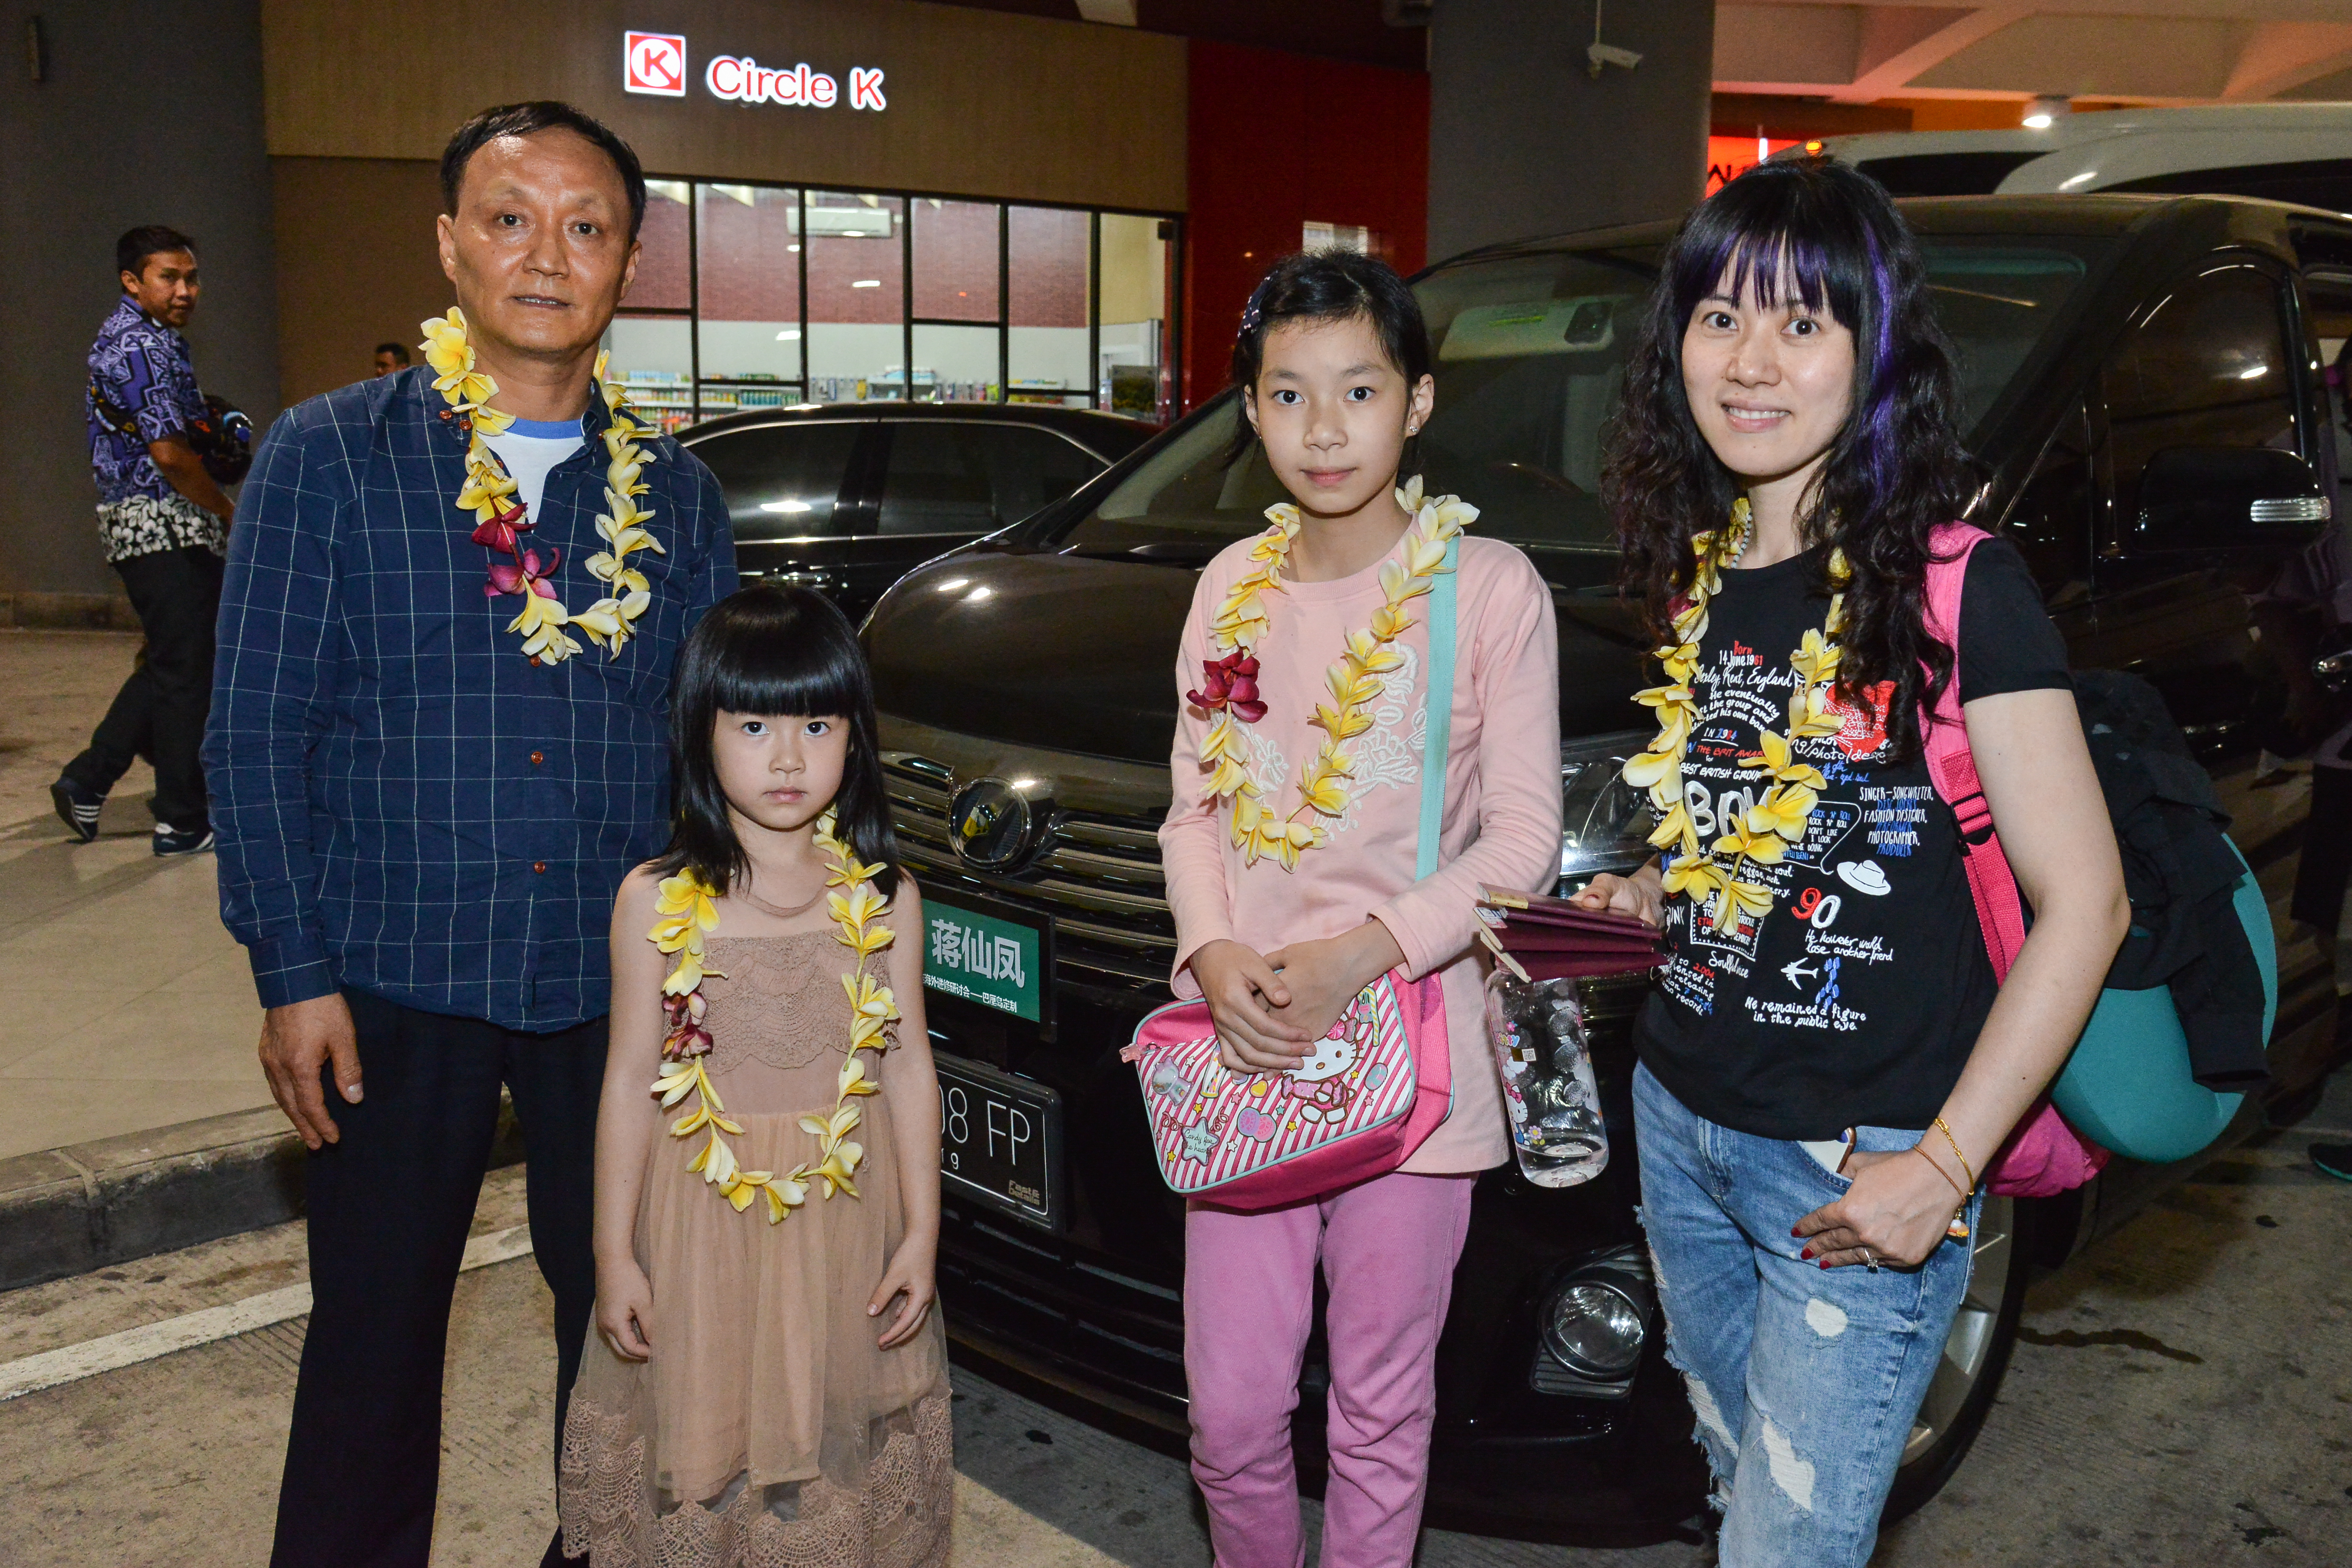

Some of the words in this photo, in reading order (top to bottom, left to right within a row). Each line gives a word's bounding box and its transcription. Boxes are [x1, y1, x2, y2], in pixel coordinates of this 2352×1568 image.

[711, 57, 835, 105] Circle
[854, 70, 884, 108] K
[1747, 666, 1794, 693] England
[1709, 690, 1722, 700] He
[1725, 689, 1781, 718] eventually
[1710, 700, 1724, 711] the
[1725, 699, 1752, 710] group
[1753, 707, 1775, 724] and
[1720, 707, 1732, 717] his
[1733, 712, 1748, 721] own
[1749, 716, 1766, 733] ban
[1703, 727, 1715, 738] IN
[1715, 728, 1738, 741] 1984
[1697, 745, 1712, 755] THE
[1713, 748, 1735, 757] BRIT
[1680, 762, 1702, 775] BEST
[1700, 767, 1732, 779] BRITISH
[1808, 817, 1822, 826] ROCK
[1837, 819, 1847, 828] ROLL
[1812, 809, 1826, 818] ROCK
[1840, 810, 1851, 820] ROLL
[1864, 809, 1895, 823] FASHION
[1808, 827, 1824, 835] DON'T
[1818, 836, 1831, 844] LOOK
[1807, 843, 1823, 852] DOING
[1876, 843, 1912, 857] PRODUCER
[1792, 887, 1841, 929] 90
[1702, 926, 1713, 935] OF
[1805, 929, 1818, 943] He
[1819, 930, 1859, 947] however
[1858, 936, 1883, 951] would
[931, 918, 1025, 988] 蒋仙凤
[1833, 946, 1870, 959] another
[1869, 948, 1893, 966] friend
[1679, 958, 1689, 966] to
[1693, 963, 1714, 979] 2004
[1674, 974, 1714, 1002] releasing
[1705, 978, 1714, 989] in
[1745, 996, 1758, 1009] He
[1761, 1002, 1818, 1015] remained
[1832, 1003, 1867, 1022] figure
[1753, 1011, 1766, 1022] in
[1771, 1012, 1792, 1025] the
[1794, 1015, 1829, 1029] public
[987, 1100, 1030, 1166] FP
[1184, 1129, 1202, 1144] Candy
[1203, 1136, 1214, 1146] for
